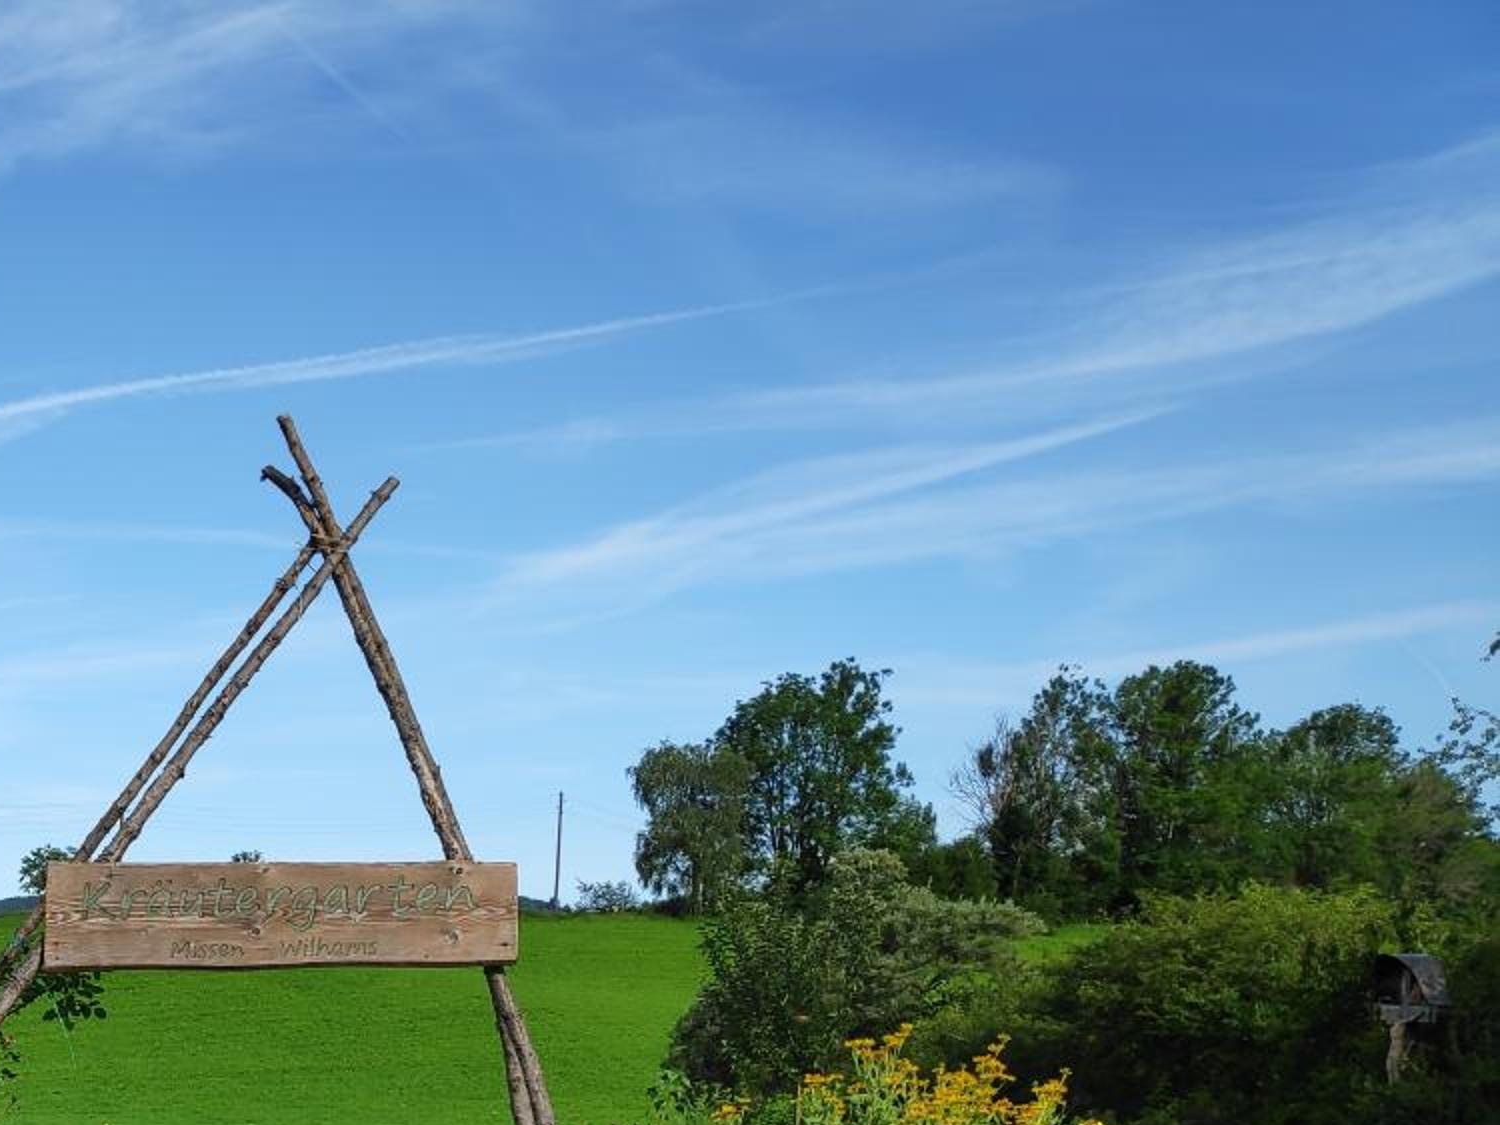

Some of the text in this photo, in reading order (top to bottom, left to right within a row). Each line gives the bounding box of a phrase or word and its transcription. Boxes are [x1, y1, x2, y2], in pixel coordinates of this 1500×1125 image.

[81, 876, 479, 930] Kräutergarten
[170, 938, 378, 960] Missen Wilhams
